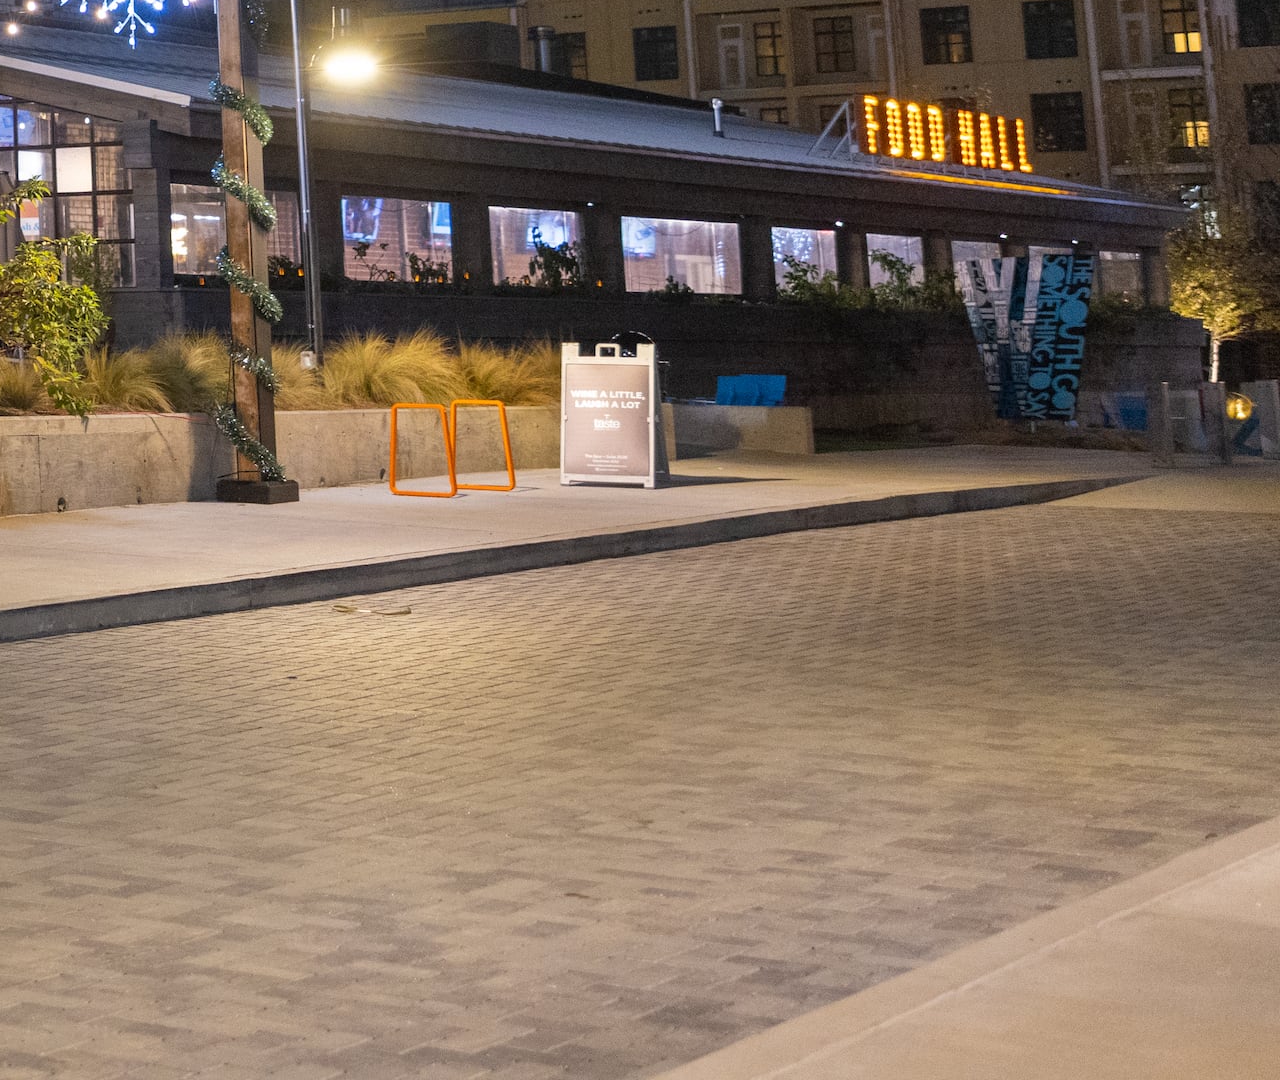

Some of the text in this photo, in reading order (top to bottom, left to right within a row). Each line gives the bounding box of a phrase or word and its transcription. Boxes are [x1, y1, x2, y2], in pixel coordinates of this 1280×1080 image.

[863, 94, 1033, 173] FOOD HALL
[1023, 255, 1068, 420] SOMETHING TO SAY
[1050, 256, 1095, 420] THE SOUTH GOT
[570, 390, 646, 400] WINE A LITTLE,
[574, 400, 640, 409] LAUGH A LOT
